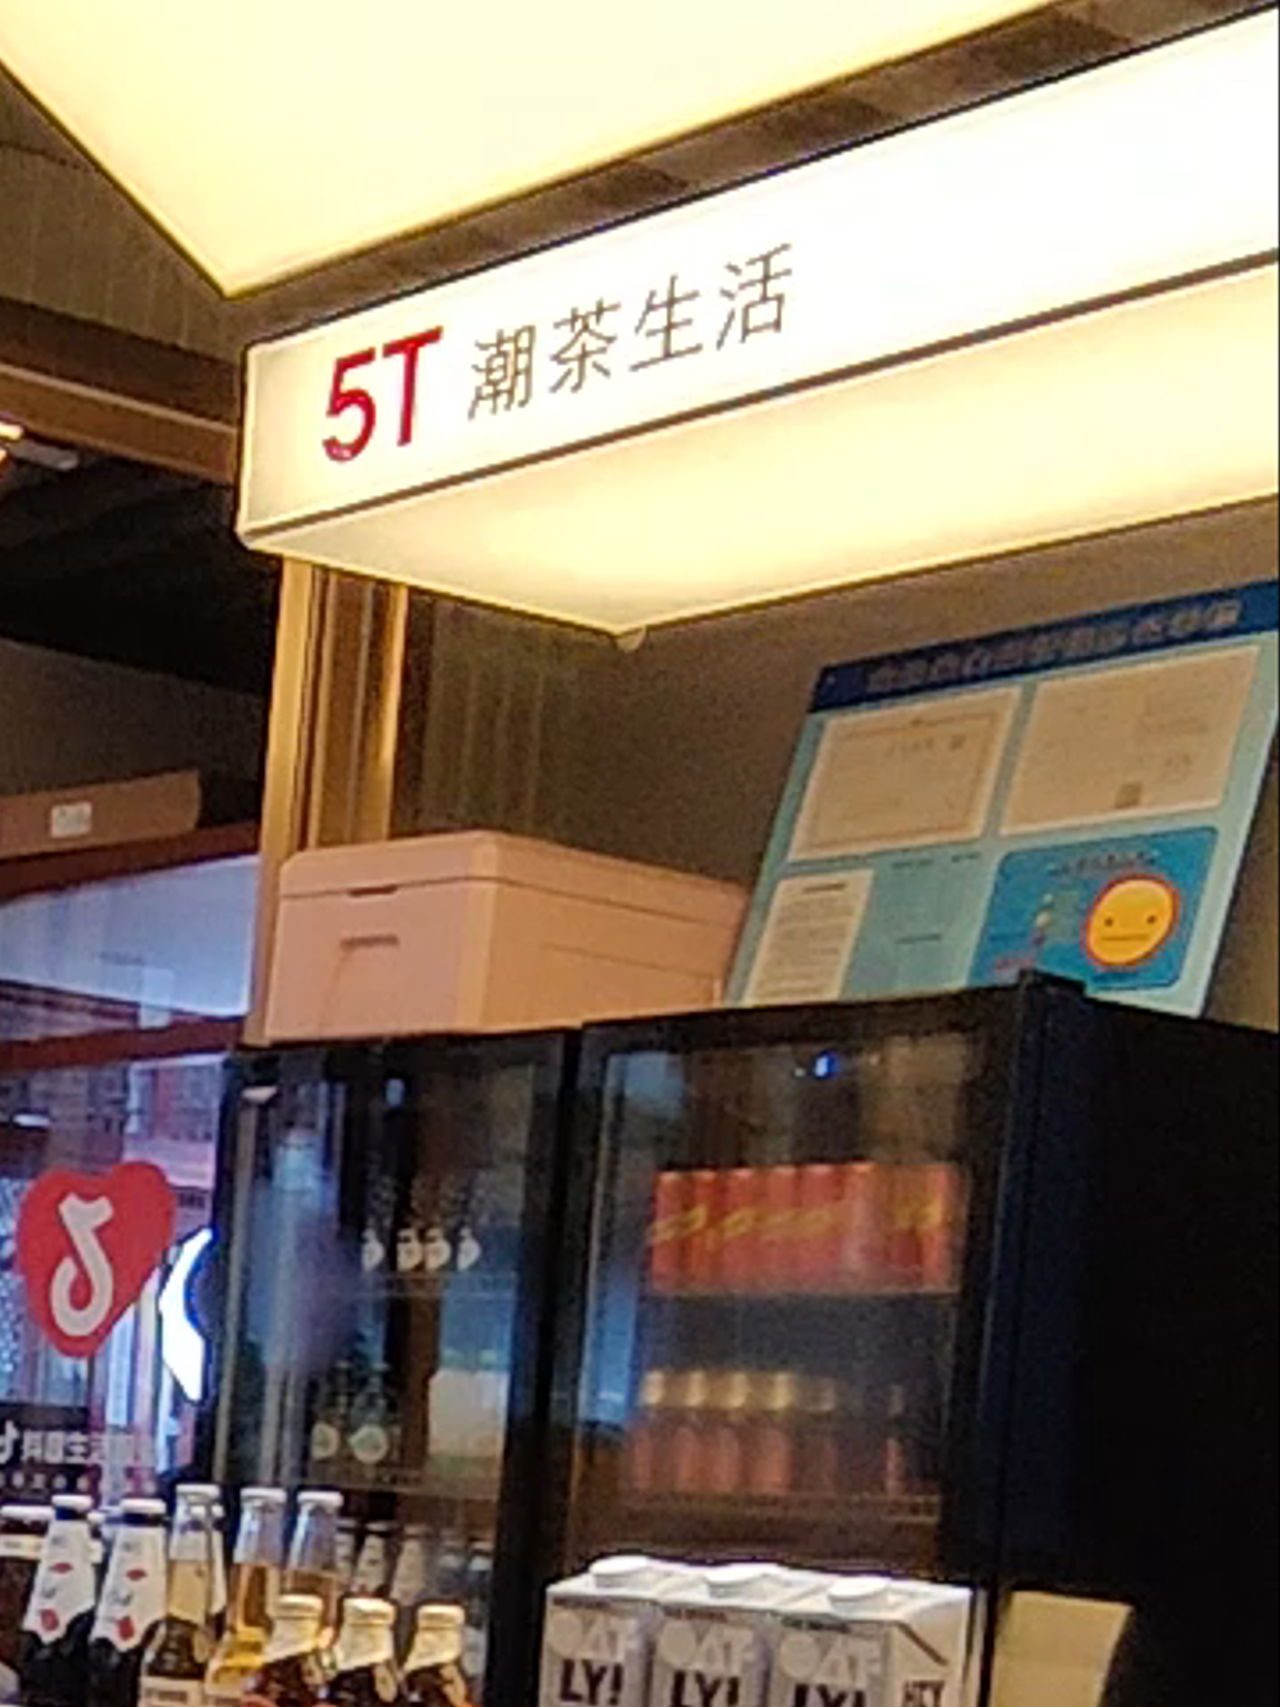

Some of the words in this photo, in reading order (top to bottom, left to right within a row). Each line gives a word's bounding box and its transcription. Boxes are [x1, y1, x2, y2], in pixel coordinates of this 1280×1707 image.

[322, 325, 444, 464] 5T
[466, 242, 794, 421] 潮茶生活
[559, 1659, 624, 1707] LY!
